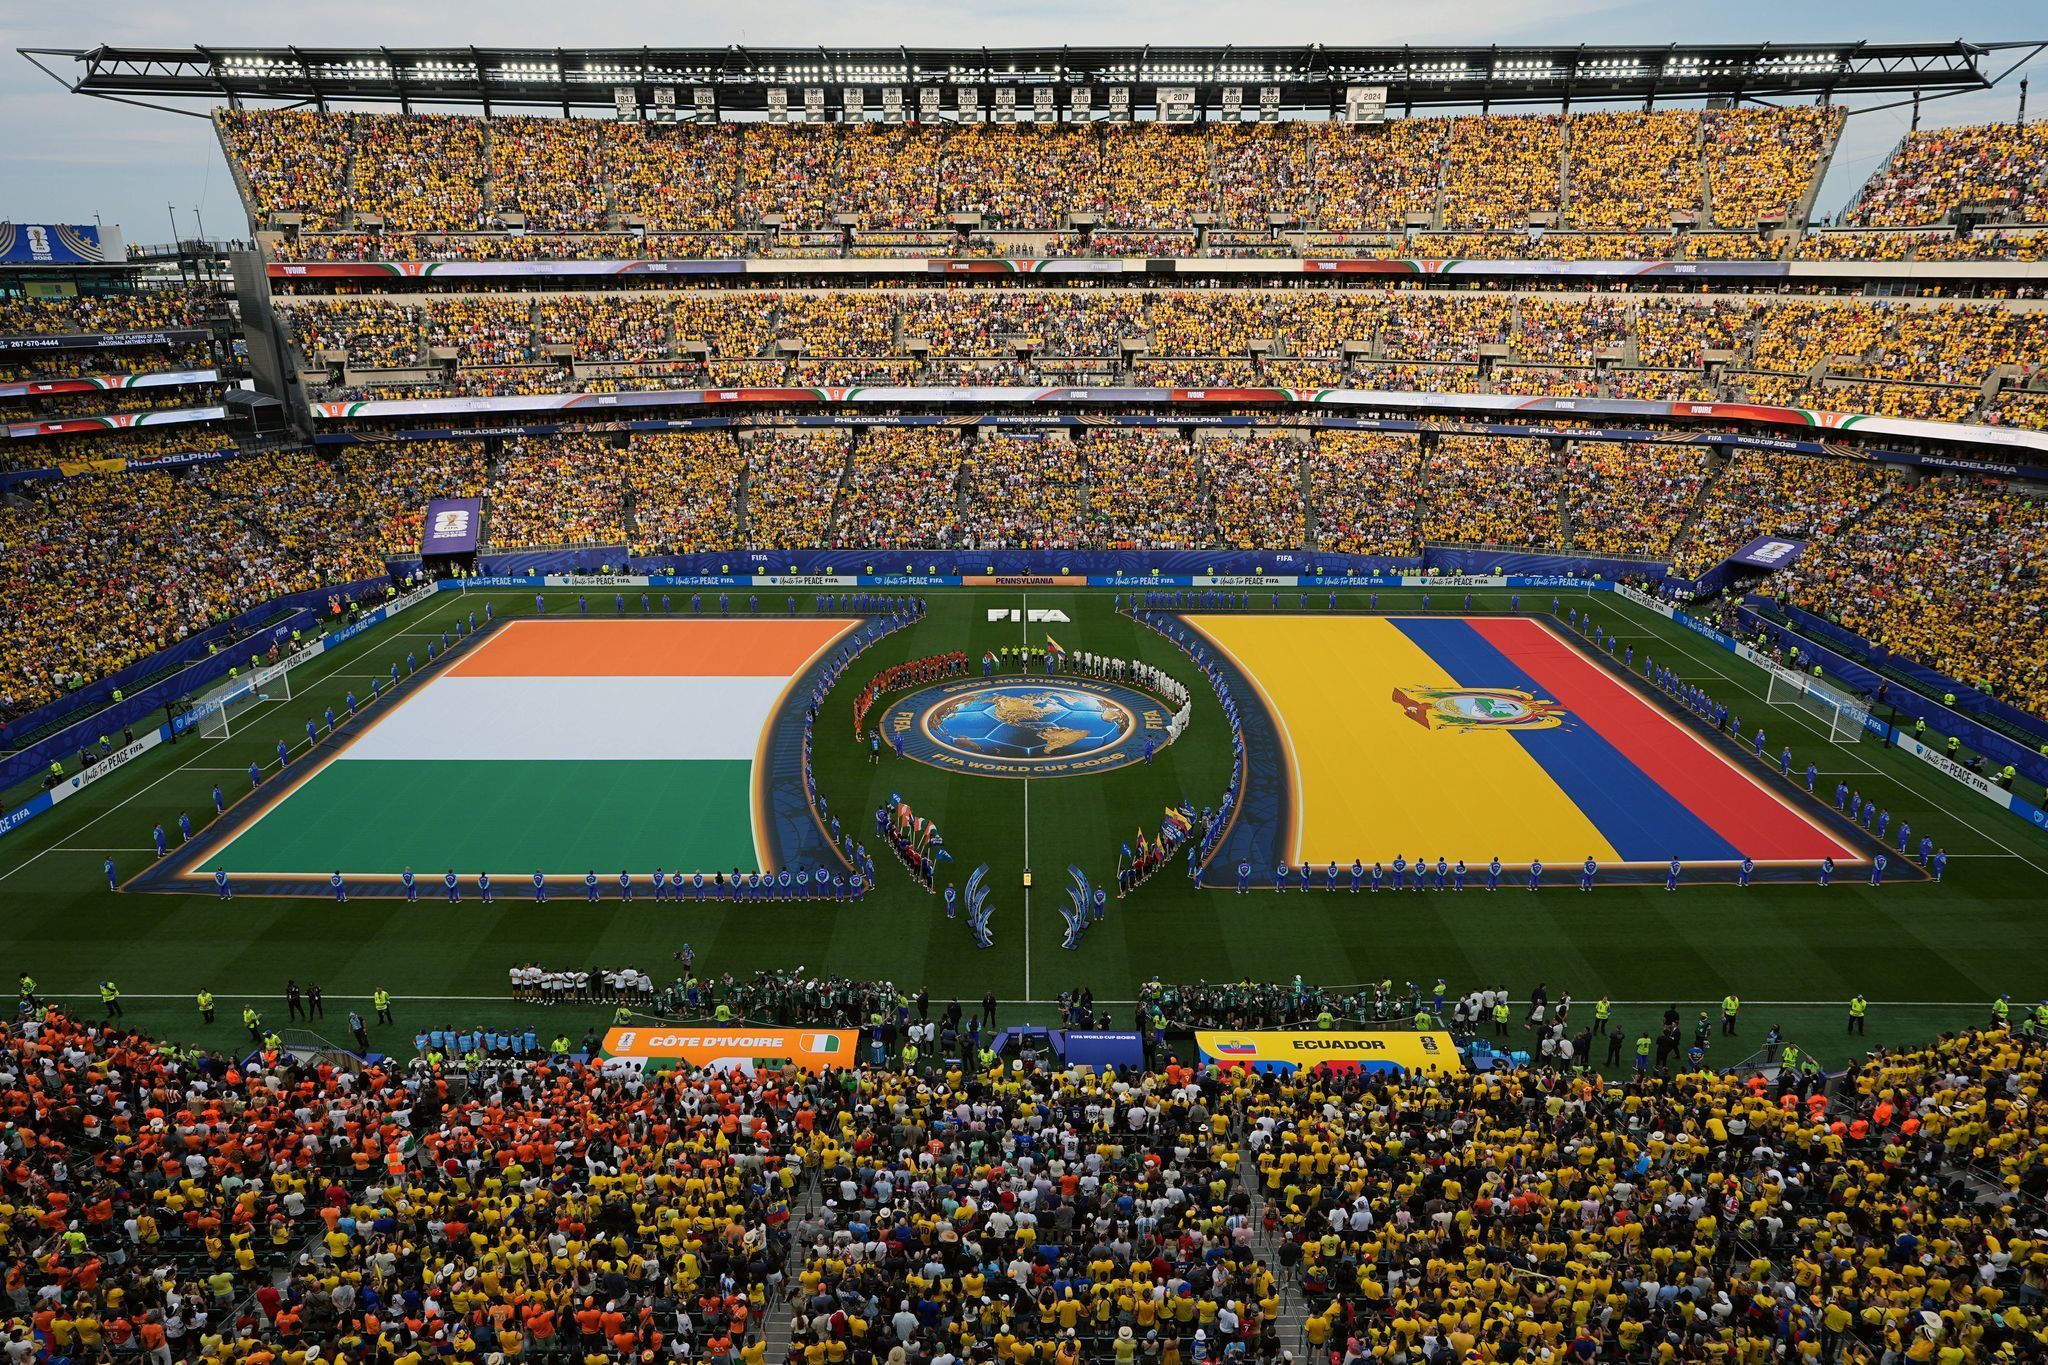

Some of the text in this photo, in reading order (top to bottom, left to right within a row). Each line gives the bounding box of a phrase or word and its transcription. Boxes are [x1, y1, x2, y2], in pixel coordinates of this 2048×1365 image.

[1073, 95, 1089, 103] 2010
[1173, 93, 1189, 101] 2017
[1070, 391, 1088, 399] IVOIRE
[1691, 405, 1712, 414] IVOIRE
[451, 427, 525, 435] PHILADELPHIA
[1529, 427, 1603, 436] PHILAELPHIA
[1737, 436, 1760, 444] WORLD
[1760, 438, 1774, 446] CUP
[1774, 440, 1797, 449] 2026
[1921, 456, 2017, 473] PHILADELPHIA
[466, 577, 483, 586] Unite
[492, 577, 512, 585] PEACE
[571, 577, 587, 586] Unite
[588, 577, 596, 585] For
[596, 577, 615, 585] PEACE
[675, 576, 691, 585] Unite
[691, 576, 700, 584] For
[779, 576, 795, 585] Unite
[795, 576, 804, 584] For
[884, 577, 899, 585] Unite
[1115, 577, 1129, 586] Unite
[1129, 577, 1139, 585] For
[1139, 577, 1159, 585] PEACE
[1219, 577, 1235, 586] Unite
[1235, 577, 1244, 585] For
[1244, 577, 1264, 585] PEACE
[1324, 577, 1339, 586] Unite
[1339, 577, 1349, 585] For
[1349, 577, 1369, 585] PEACE
[1428, 577, 1443, 586] Unite
[1444, 577, 1453, 585] For
[1533, 577, 1548, 586] Unite
[1548, 577, 1558, 586] For
[1558, 578, 1579, 586] PEACE
[988, 608, 1071, 622] FIFA
[275, 626, 288, 637] FIFA
[943, 680, 992, 693] 2026
[893, 711, 914, 732] FIFA
[1142, 710, 1162, 730] FIFA
[1868, 718, 1882, 731] FIFA
[82, 743, 144, 784] Unite For PEACE FIFA
[931, 752, 1126, 772] FIFA WORLD CUP 2026
[1923, 749, 1988, 793] Unite For PEACE FIFA
[12, 808, 30, 824] FIFA
[649, 1034, 785, 1047] CÔTE D'IVOIRE
[1292, 1040, 1386, 1050] ECUADOR
[1233, 1070, 1241, 1079] 23
[1088, 1111, 1098, 1119] 39
[933, 1145, 939, 1154] 11
[1014, 1184, 1023, 1192] 10
[921, 1227, 929, 1235] 10
[629, 1263, 637, 1274] 11
